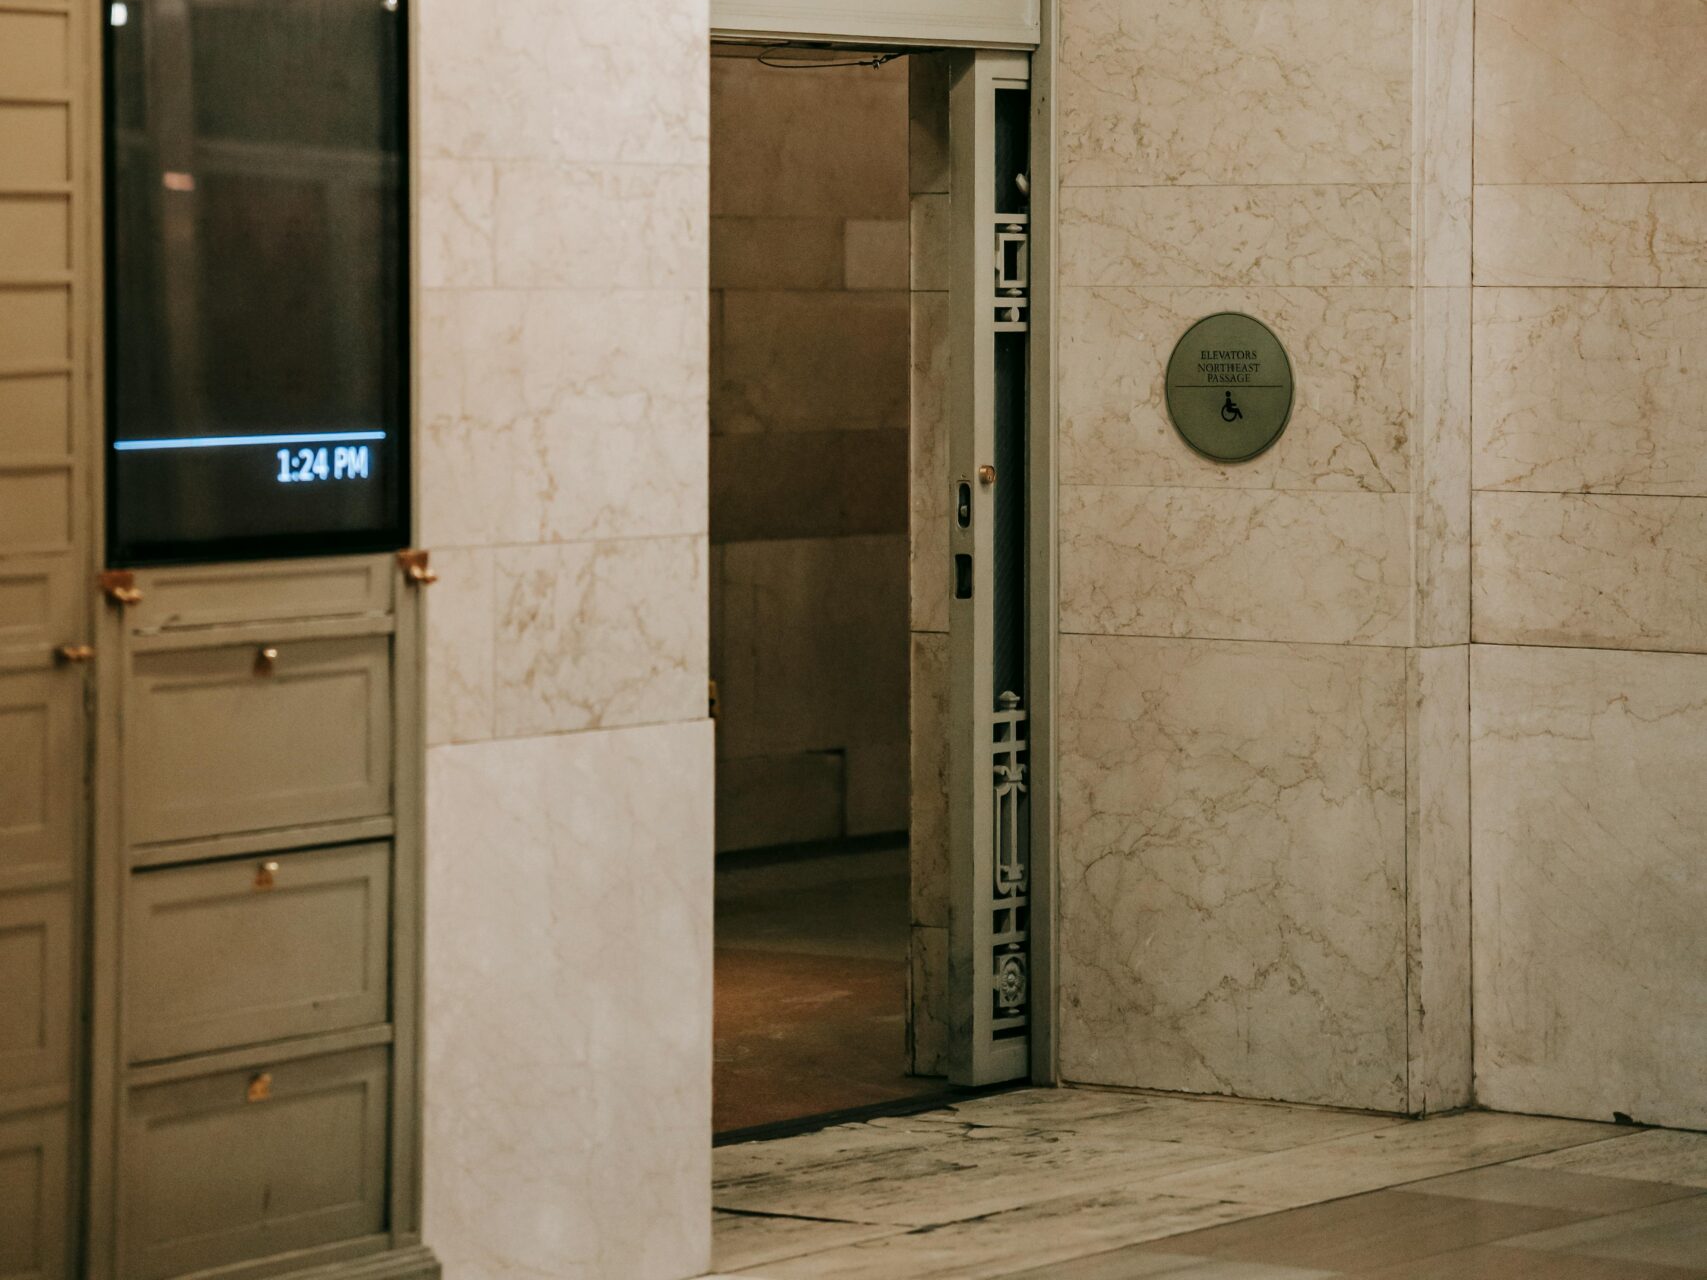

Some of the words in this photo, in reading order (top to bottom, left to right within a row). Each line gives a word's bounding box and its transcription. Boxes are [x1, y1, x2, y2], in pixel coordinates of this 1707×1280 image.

[1201, 350, 1258, 361] ELEVATORS
[1198, 363, 1261, 373] NORTHEAST
[1207, 373, 1251, 383] PASSAGE
[276, 447, 329, 483] 1:24
[333, 445, 369, 480] PM
